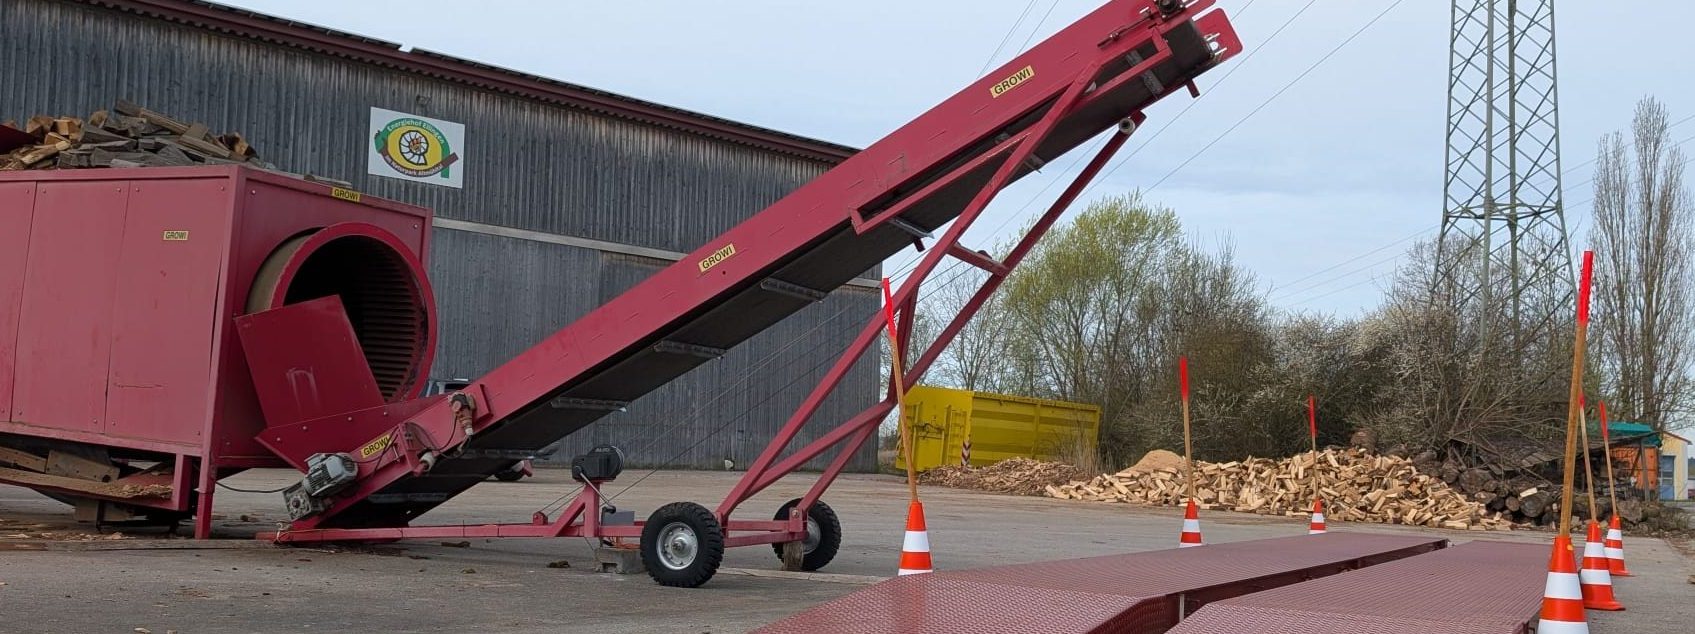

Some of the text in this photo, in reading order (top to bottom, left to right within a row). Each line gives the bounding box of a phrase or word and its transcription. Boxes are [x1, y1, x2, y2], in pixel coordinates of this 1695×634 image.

[994, 68, 1031, 94] GROWI
[334, 188, 359, 200] GROWI
[165, 231, 187, 240] GROWI
[702, 246, 733, 268] GROWI
